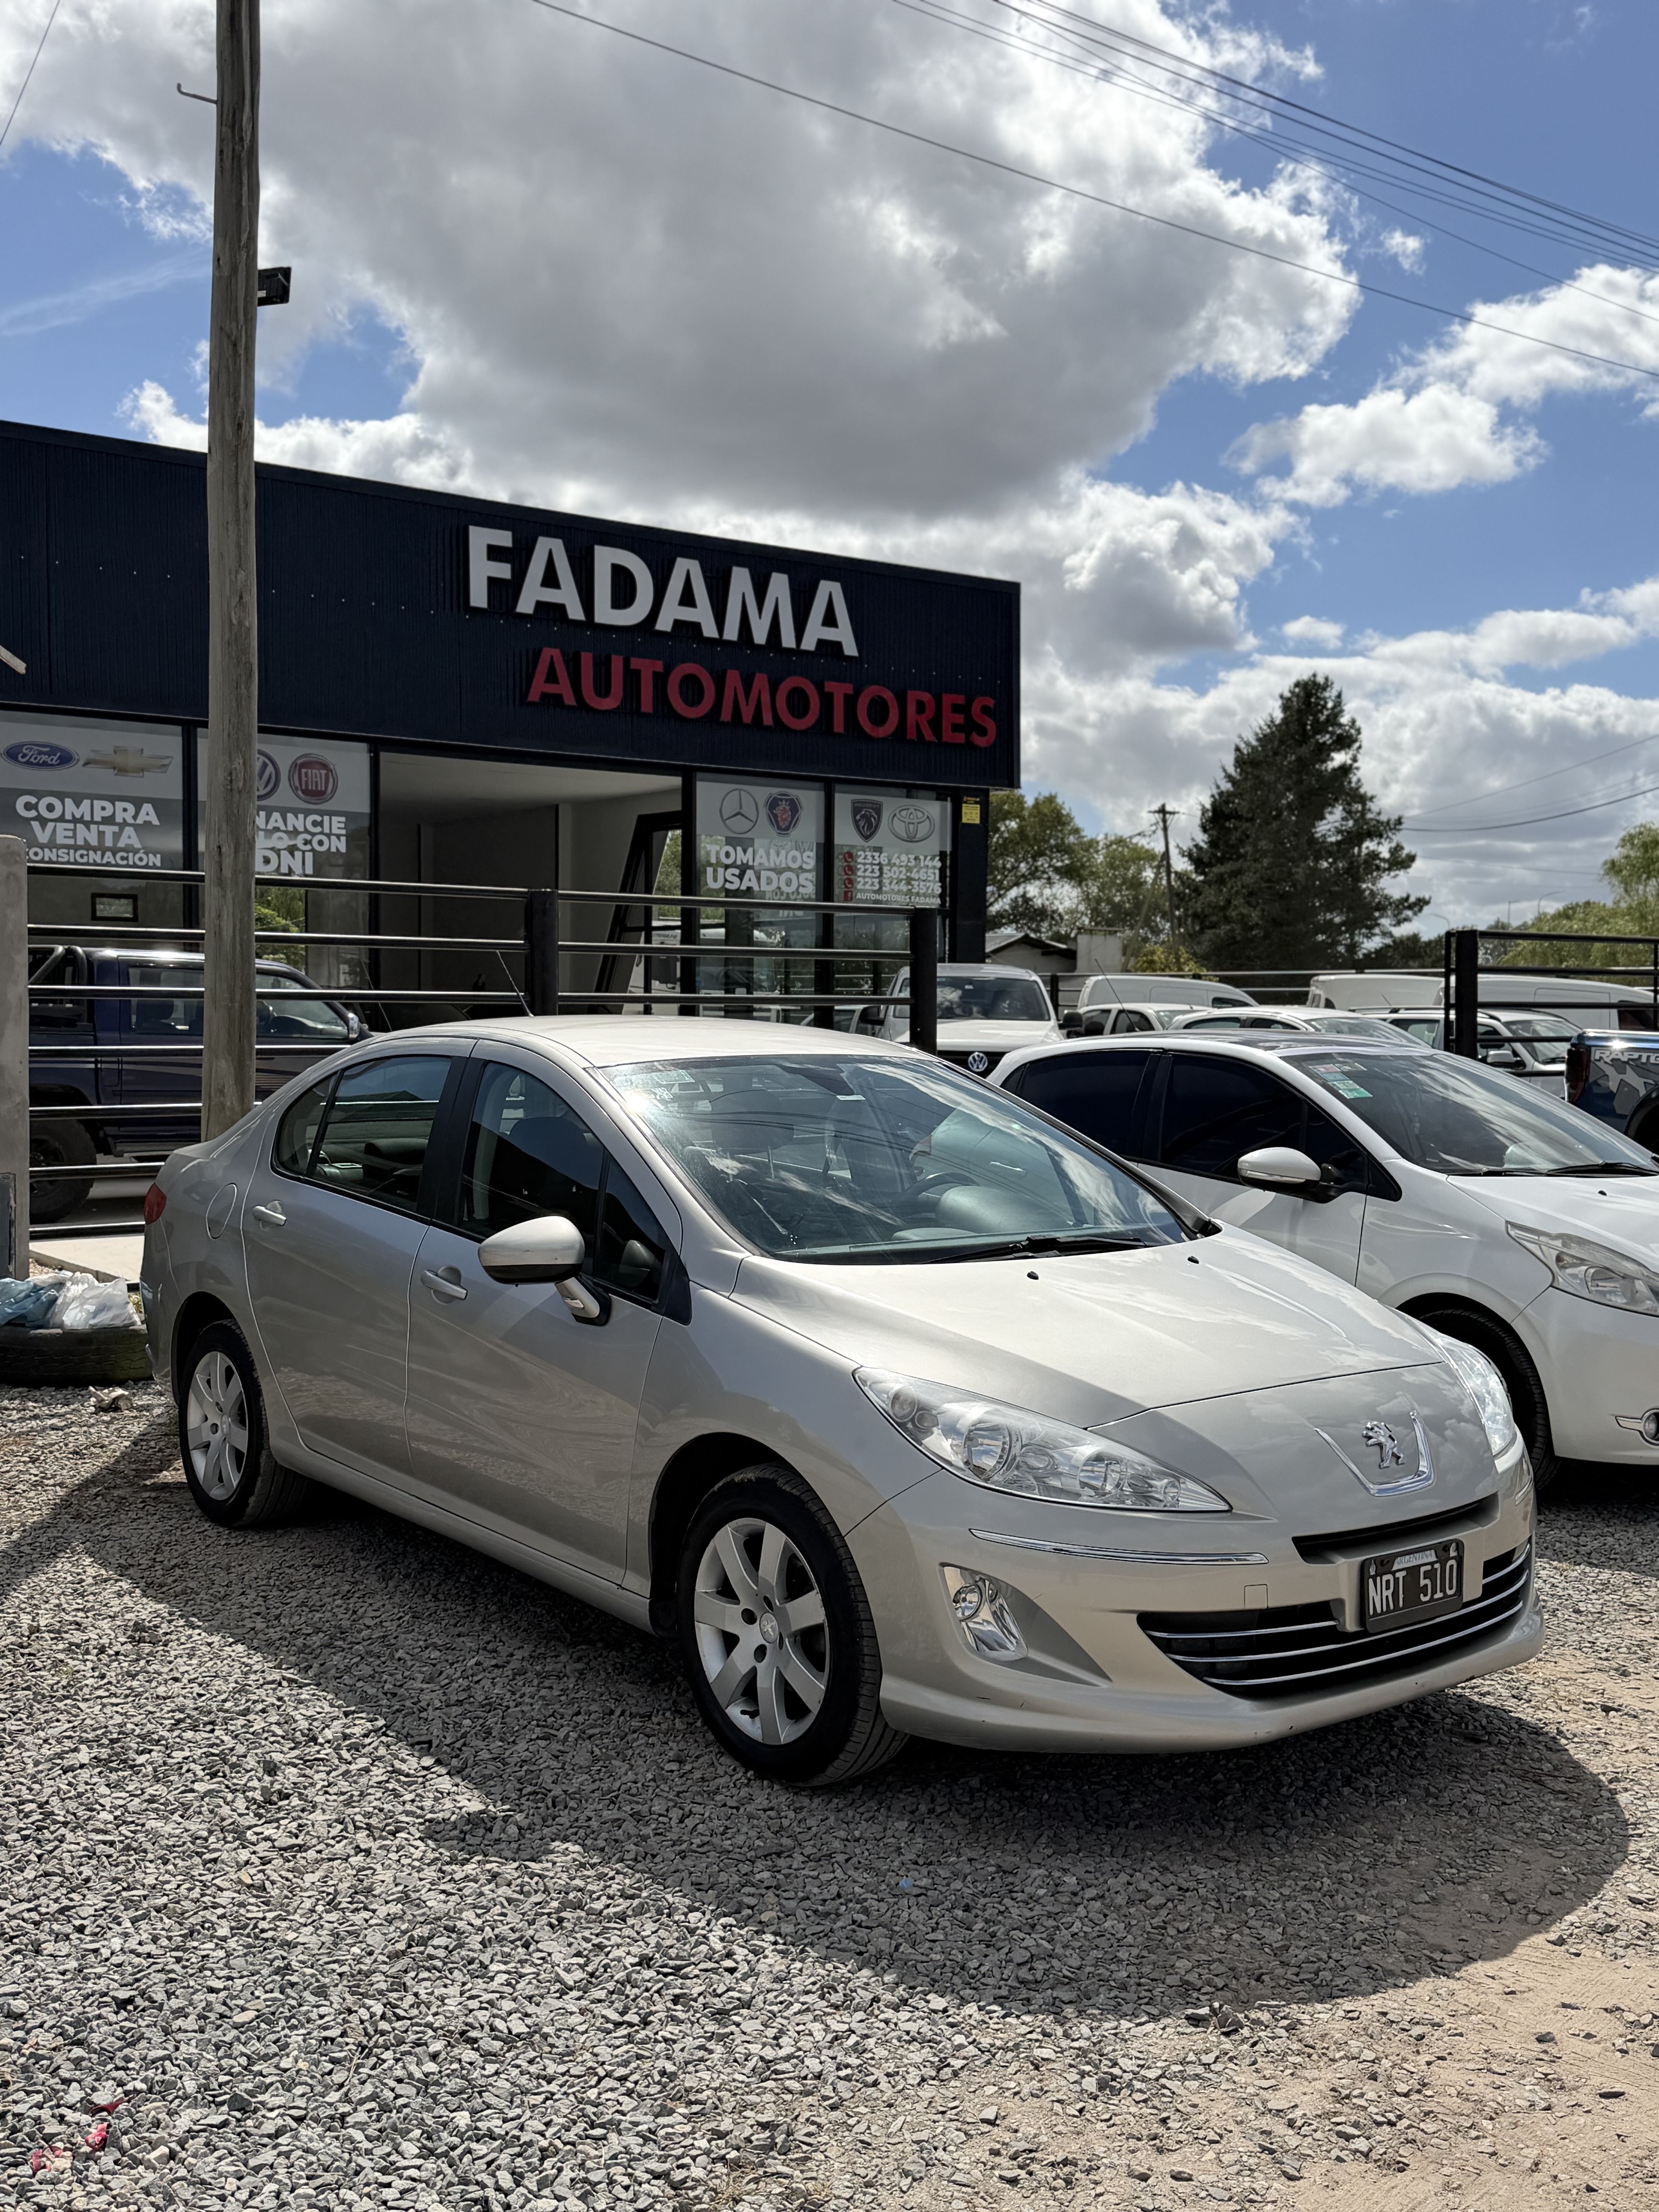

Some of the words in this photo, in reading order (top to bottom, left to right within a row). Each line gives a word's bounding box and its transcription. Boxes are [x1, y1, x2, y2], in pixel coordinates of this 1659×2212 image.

[469, 525, 859, 657] FADAMA
[527, 647, 996, 747] AUTOMOTORES
[18, 745, 60, 765] Ford
[301, 768, 327, 791] FIAT
[15, 795, 160, 825] COMPRA
[256, 811, 346, 834] NANCIE
[30, 821, 142, 848] VENTA
[296, 833, 346, 853] CON
[26, 847, 161, 867] ONSIGNACIÓN
[255, 848, 313, 874] DNI
[706, 844, 815, 870] TOMAMOS
[857, 851, 888, 865] 2336
[891, 853, 915, 867] 493
[919, 855, 942, 869] 144
[706, 867, 814, 893] USADOS
[856, 864, 880, 877] 223
[883, 866, 939, 881] 502-4651
[856, 878, 879, 890] 223
[882, 879, 942, 894] 344-3576
[856, 892, 910, 902] AUTOMOTORES
[911, 896, 941, 905] FADAMA
[1395, 1549, 1433, 1565] ARGENTINA
[1368, 1570, 1407, 1616] NRT
[1420, 1559, 1457, 1602] 510
